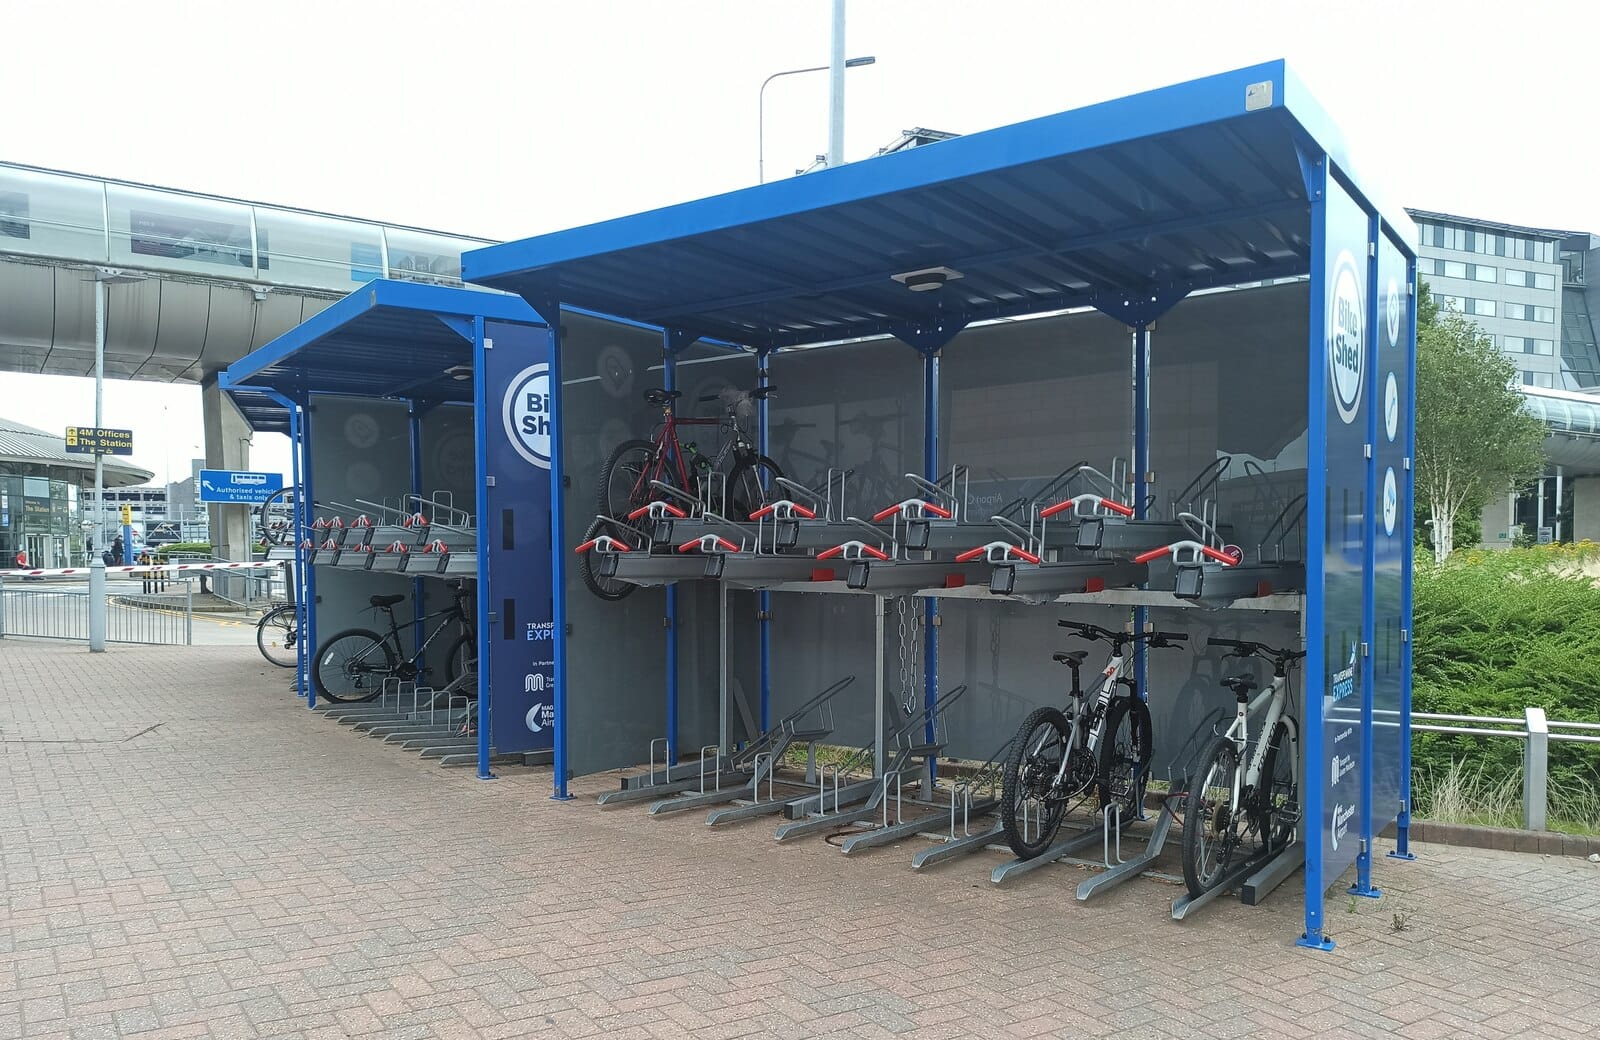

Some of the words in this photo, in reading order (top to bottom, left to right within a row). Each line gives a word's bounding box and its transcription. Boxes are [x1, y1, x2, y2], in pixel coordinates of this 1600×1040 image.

[1338, 296, 1357, 337] Bike
[1336, 333, 1359, 374] Shed
[79, 428, 94, 437] 4M
[96, 429, 130, 439] Offices
[522, 415, 551, 436] Sh
[79, 437, 97, 446] The
[100, 438, 133, 448] Station
[527, 629, 554, 641] EXP
